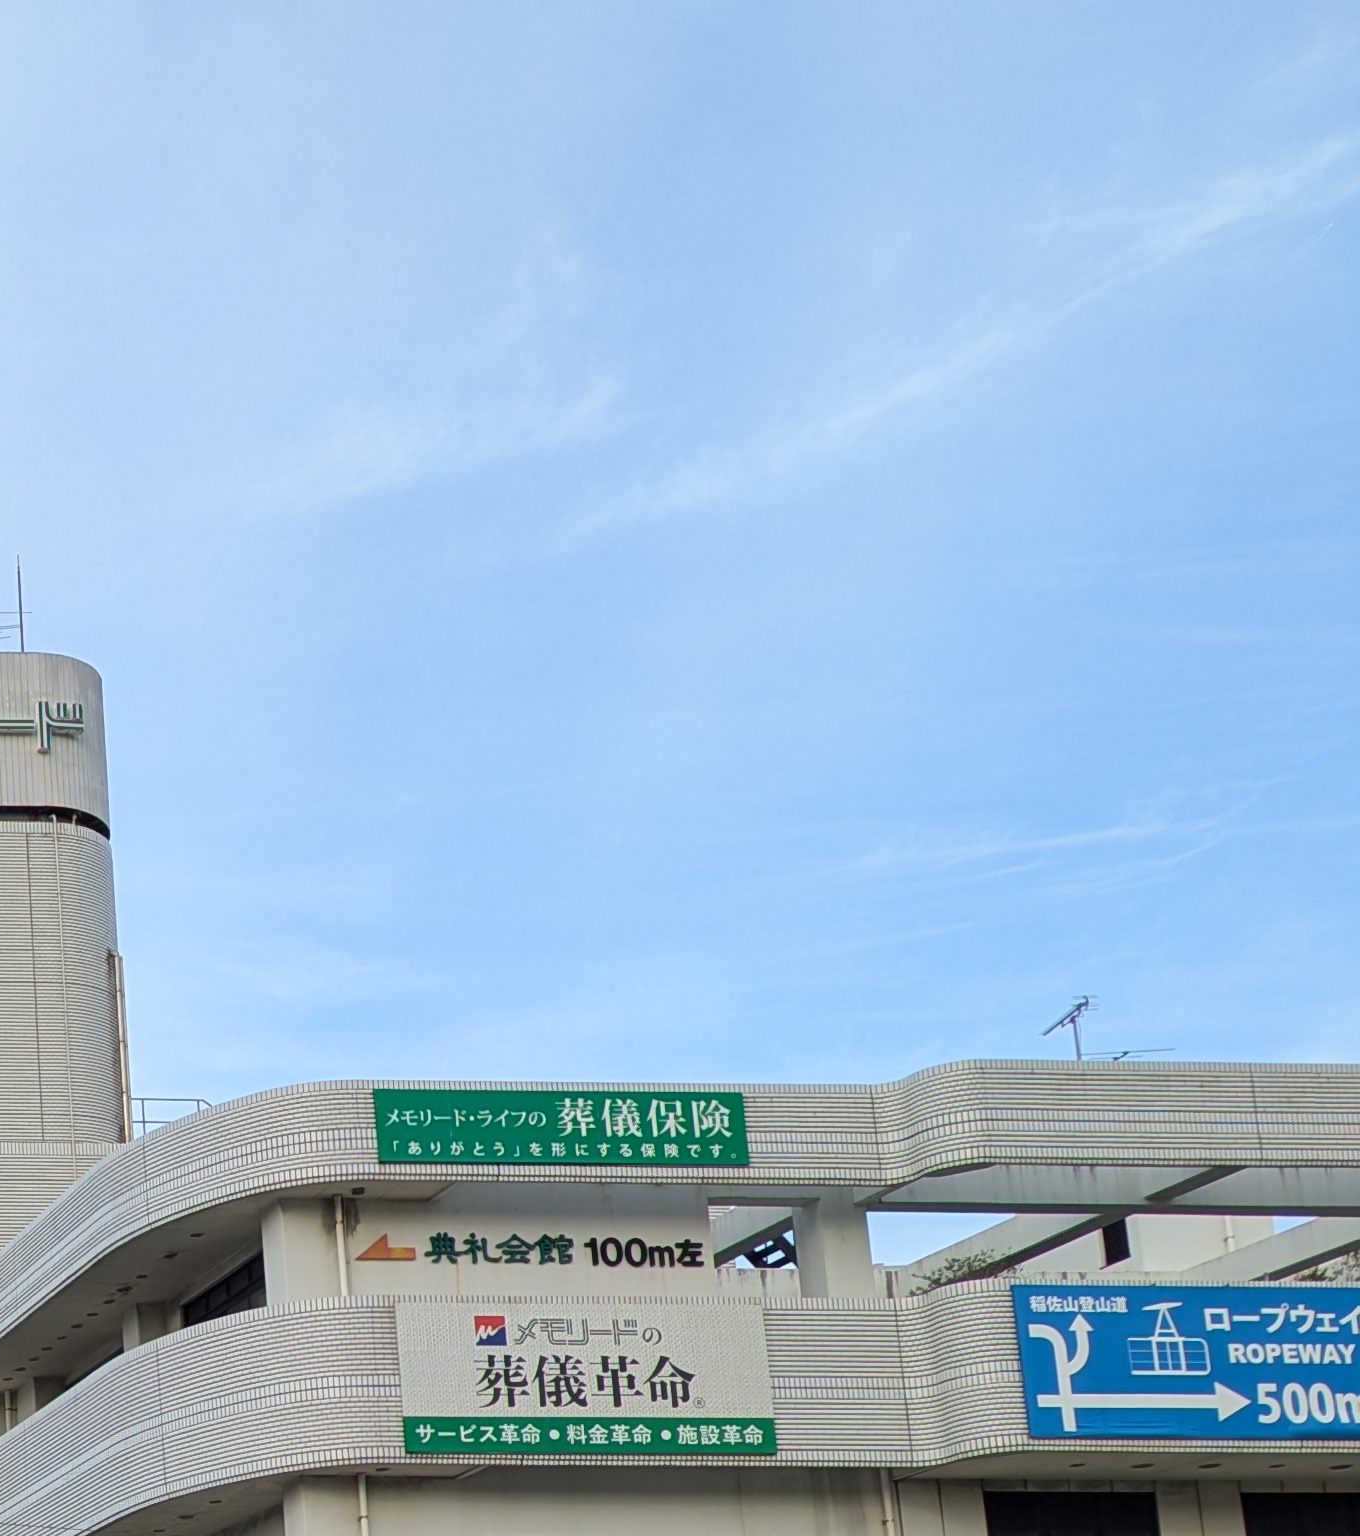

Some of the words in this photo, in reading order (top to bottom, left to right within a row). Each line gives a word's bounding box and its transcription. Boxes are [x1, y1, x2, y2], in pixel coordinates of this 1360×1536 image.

[554, 1097, 734, 1139] 葬儀保険
[424, 1232, 575, 1266] 典礼会館
[583, 1237, 705, 1268] 100m左
[1029, 1295, 1129, 1314] 稲佐山登山道
[514, 1317, 663, 1346] メモリードの
[1228, 1343, 1356, 1365] ROPEWAY
[473, 1353, 697, 1410] 葬儀革命
